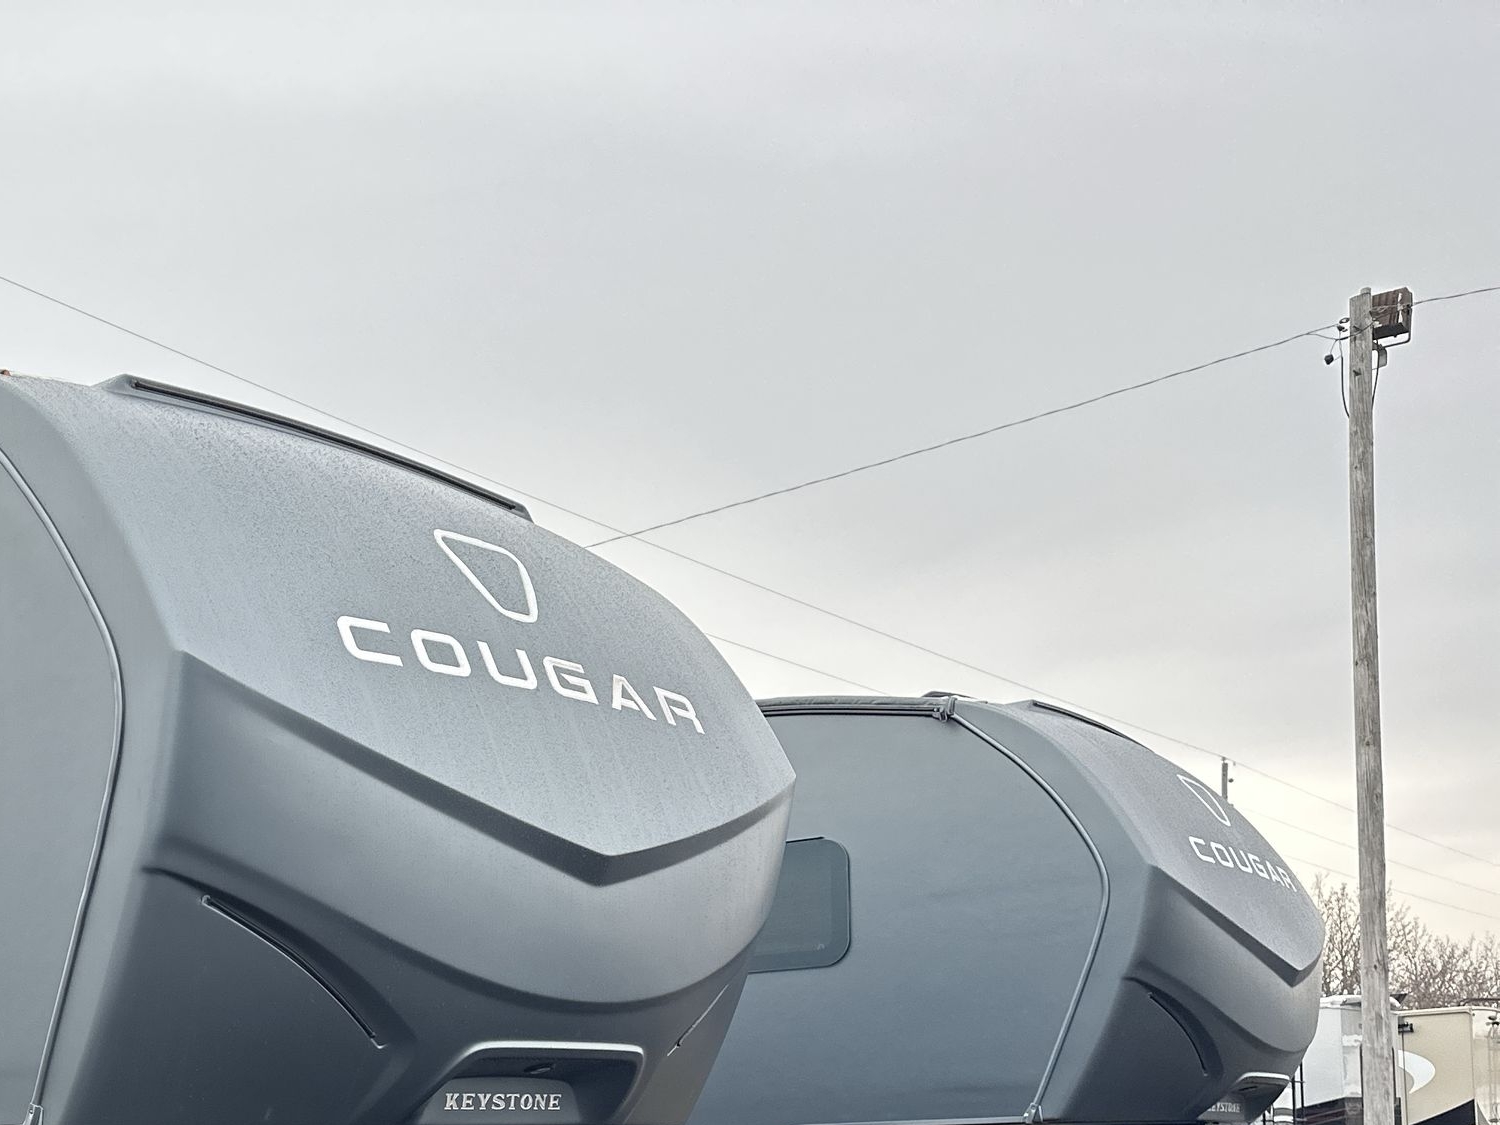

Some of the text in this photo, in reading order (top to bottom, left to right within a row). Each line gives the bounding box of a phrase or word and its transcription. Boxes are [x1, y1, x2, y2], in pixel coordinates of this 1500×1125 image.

[336, 614, 706, 735] COUGAR
[1188, 836, 1298, 893] COUGAR
[443, 1092, 562, 1111] KEYSTONE
